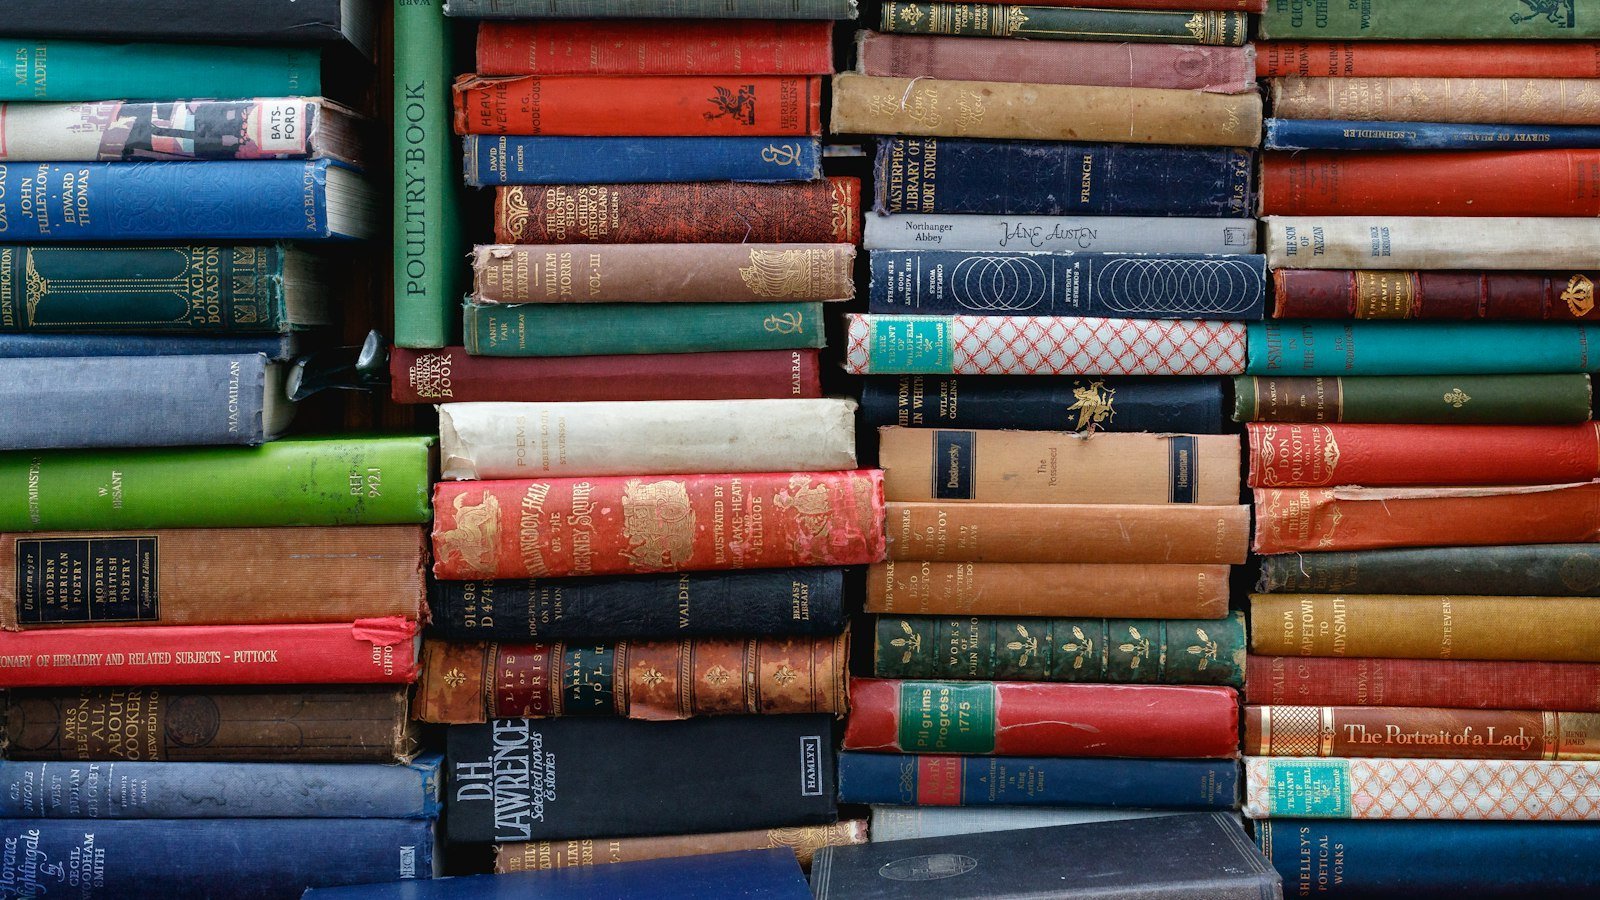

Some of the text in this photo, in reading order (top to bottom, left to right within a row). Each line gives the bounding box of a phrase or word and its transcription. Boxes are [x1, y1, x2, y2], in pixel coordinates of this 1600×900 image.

[16, 48, 28, 86] MILES
[271, 106, 281, 140] BATS-
[285, 107, 296, 140] FORD
[532, 76, 541, 134] WODEHOUSE
[781, 80, 789, 129] HERBERT
[790, 80, 798, 130] JENKINS
[1343, 128, 1406, 140] SCHMEIDLER
[1512, 132, 1551, 142] SURVEY
[499, 136, 507, 182] COPPERFIELD
[906, 139, 920, 211] LIBRARY OF
[922, 138, 937, 213] SHORT STORIES
[1081, 154, 1093, 203] FRENCH
[21, 177, 33, 219] JOHN
[36, 163, 51, 235] FULLEYLOVE
[63, 172, 76, 224] EDWARD
[77, 169, 91, 227] THOMAS
[547, 188, 556, 235] THE OLD
[566, 195, 576, 227] SHOP
[578, 187, 588, 227] CHILD'S
[589, 198, 599, 240] HISTORY
[598, 187, 608, 235] ENGLAND
[905, 221, 953, 233] Northanger
[915, 233, 943, 244] Abbey
[1286, 226, 1297, 256] THE SON
[1300, 236, 1310, 247] OF
[1312, 226, 1324, 256] TARZAN
[1, 248, 14, 327] IDENTIFICATION
[206, 246, 220, 324] BORASTON
[487, 265, 498, 286] THE
[517, 250, 529, 299] PARADISE
[546, 252, 557, 297] WILLIAM
[560, 252, 572, 296] MORRIS
[416, 355, 424, 397] ARTHUR
[423, 354, 432, 398] RACKHAM
[431, 353, 441, 398] FAIRY
[441, 353, 453, 398] BOOK
[792, 352, 801, 394] HARRAP
[229, 360, 240, 433] MACMILLAN
[940, 381, 948, 417] WILKIE
[949, 379, 957, 419] COLLINS
[517, 416, 527, 467] POEMS
[559, 416, 567, 465] STEVENSON
[1279, 438, 1290, 468] DON
[1291, 426, 1303, 481] QUIXOTE
[1312, 427, 1321, 481] CERVANTES
[368, 467, 382, 498] 942.1
[947, 443, 961, 489] Dostoevsky
[1037, 459, 1046, 475] The
[1049, 447, 1057, 487] Possessed
[1178, 450, 1188, 488] Heinemann
[99, 484, 109, 497] W.
[522, 482, 551, 514] HALL
[551, 511, 562, 552] OR THE
[714, 484, 724, 565] ILLUSTRATED BY
[751, 496, 762, 555] JELLICOE
[1289, 499, 1300, 533] THREE
[25, 553, 34, 610] Untermeyer
[47, 559, 55, 604] MODERN
[60, 552, 69, 610] AMERICAN
[73, 559, 82, 603] POETRY
[95, 557, 104, 604] MODERN
[109, 557, 117, 603] BRITISH
[122, 558, 131, 602] POETRY
[141, 552, 150, 576] Edition
[464, 582, 476, 628] 914.98
[541, 587, 550, 624] ON THE
[555, 587, 563, 620] YUKON
[679, 573, 689, 629] WALDEN
[793, 581, 801, 620] BELFAST
[801, 582, 809, 621] LIBRARY
[910, 575, 918, 598] LEO
[919, 561, 930, 612] TOLSTOY
[950, 621, 959, 666] WORKS
[961, 638, 968, 650] OF
[1283, 610, 1294, 646] FROM
[1320, 621, 1328, 637] TO
[36, 650, 278, 667] OF HERALDRY AND RELATED SUBJECTS PUTTOCK
[506, 654, 516, 702] LIFE
[532, 643, 543, 710] CHRIST
[573, 648, 582, 700] FARRAR.
[65, 708, 77, 741] MRS
[92, 704, 106, 741] ALL
[108, 691, 125, 756] ABOUT
[936, 688, 951, 749] Progress
[960, 701, 971, 733] 1775
[1343, 724, 1535, 750] The Portrait of a Lady
[456, 755, 494, 802] D.H.
[493, 718, 531, 842] LAWRENCE
[530, 731, 545, 823] Selected novels
[544, 752, 556, 802] & stories
[806, 743, 816, 789] HAMLYN
[928, 759, 940, 795] Mark
[52, 774, 62, 809] WEST
[88, 763, 100, 818] CRICKET
[1286, 771, 1294, 809] TENANT
[1313, 779, 1321, 804] HALL
[70, 846, 81, 887] CECIL
[94, 848, 105, 888] SMITH
[1300, 827, 1311, 897] SHELLEY'S
[1318, 835, 1328, 891] POETICAL
[1335, 843, 1344, 885] WORKS
